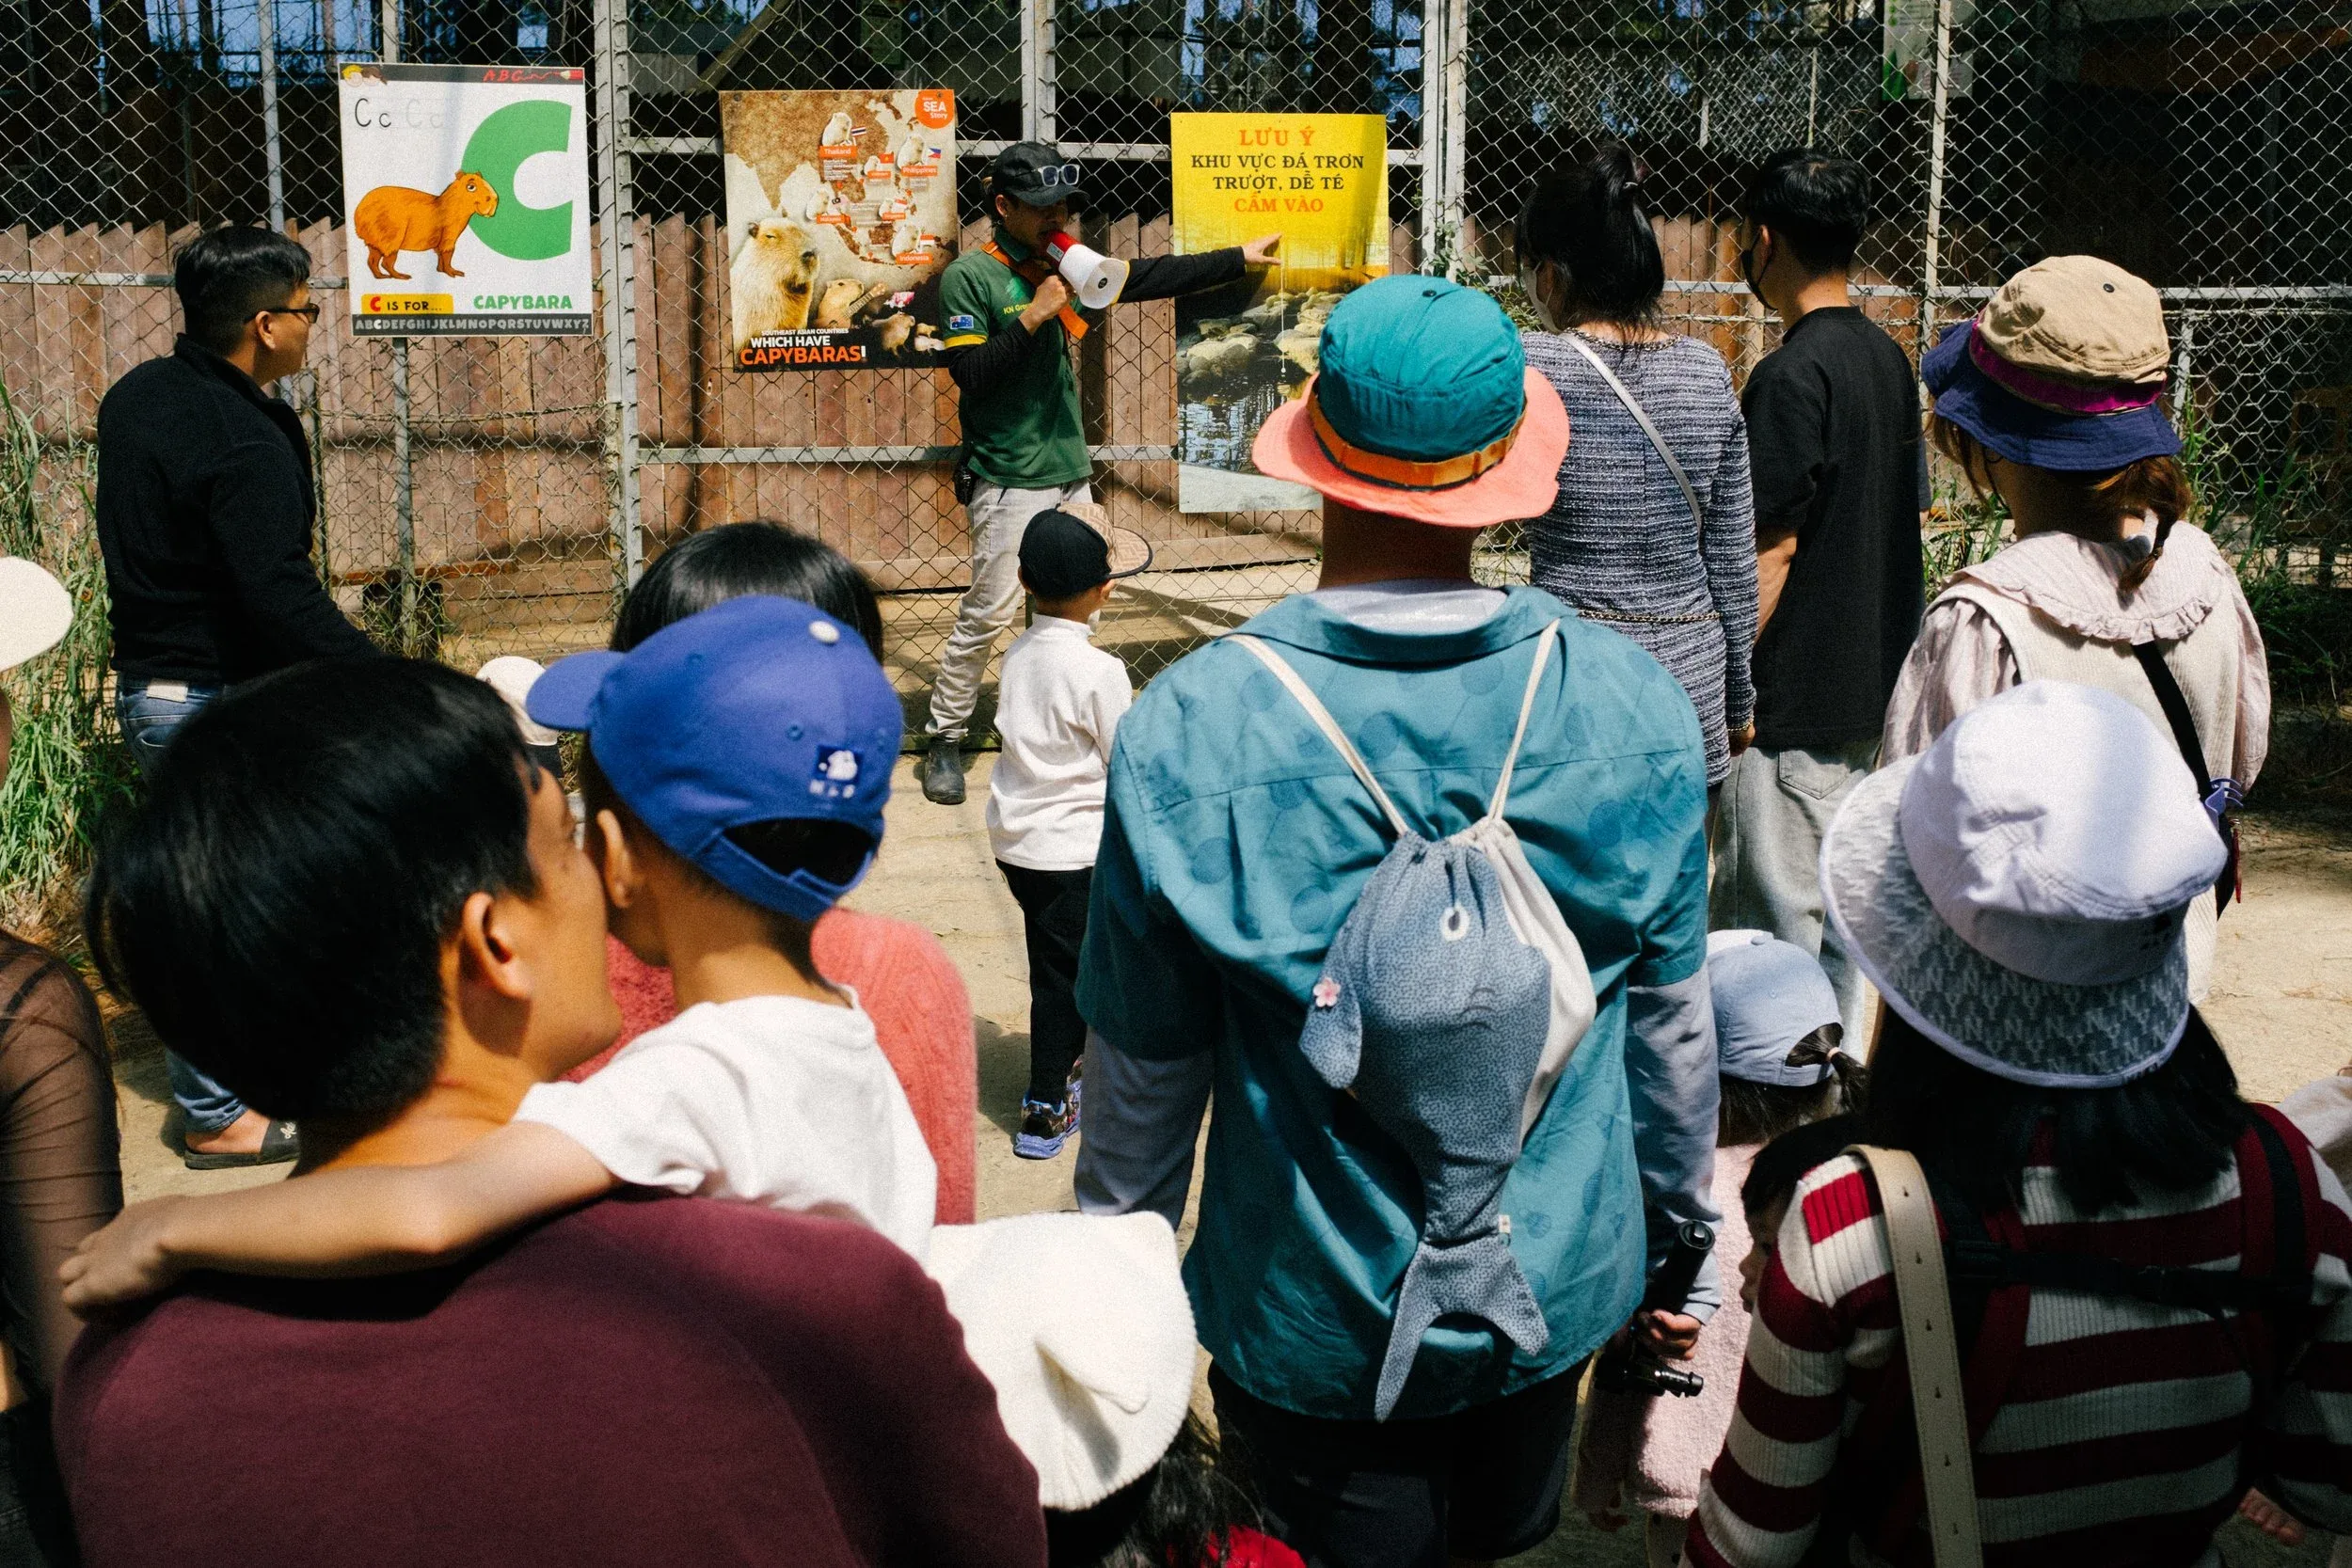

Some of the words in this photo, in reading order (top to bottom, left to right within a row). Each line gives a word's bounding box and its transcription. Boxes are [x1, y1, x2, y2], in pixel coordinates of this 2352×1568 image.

[923, 101, 946, 112] SEA
[1239, 127, 1290, 146] LƯU
[1299, 125, 1315, 146] Ý
[1191, 155, 1232, 168] KHU
[1237, 153, 1277, 172] VỰC
[1282, 151, 1309, 168] ĐÁ
[1313, 153, 1364, 168] TRƠN
[461, 99, 574, 261] C
[1213, 174, 1283, 194] TRƯỢT,
[1321, 174, 1344, 190] TÉ
[1233, 191, 1277, 213] CẤM
[1285, 195, 1324, 213] VÀO
[370, 295, 382, 312] C
[387, 301, 398, 311] IS
[473, 294, 573, 310] CAPYBARA
[355, 318, 590, 331] ABCDEFGHIJKLMNOPQRSTUVWXYZ
[751, 336, 793, 348] WHICH
[795, 335, 831, 347] HAVE
[740, 345, 867, 365] CAPYBARAS!
